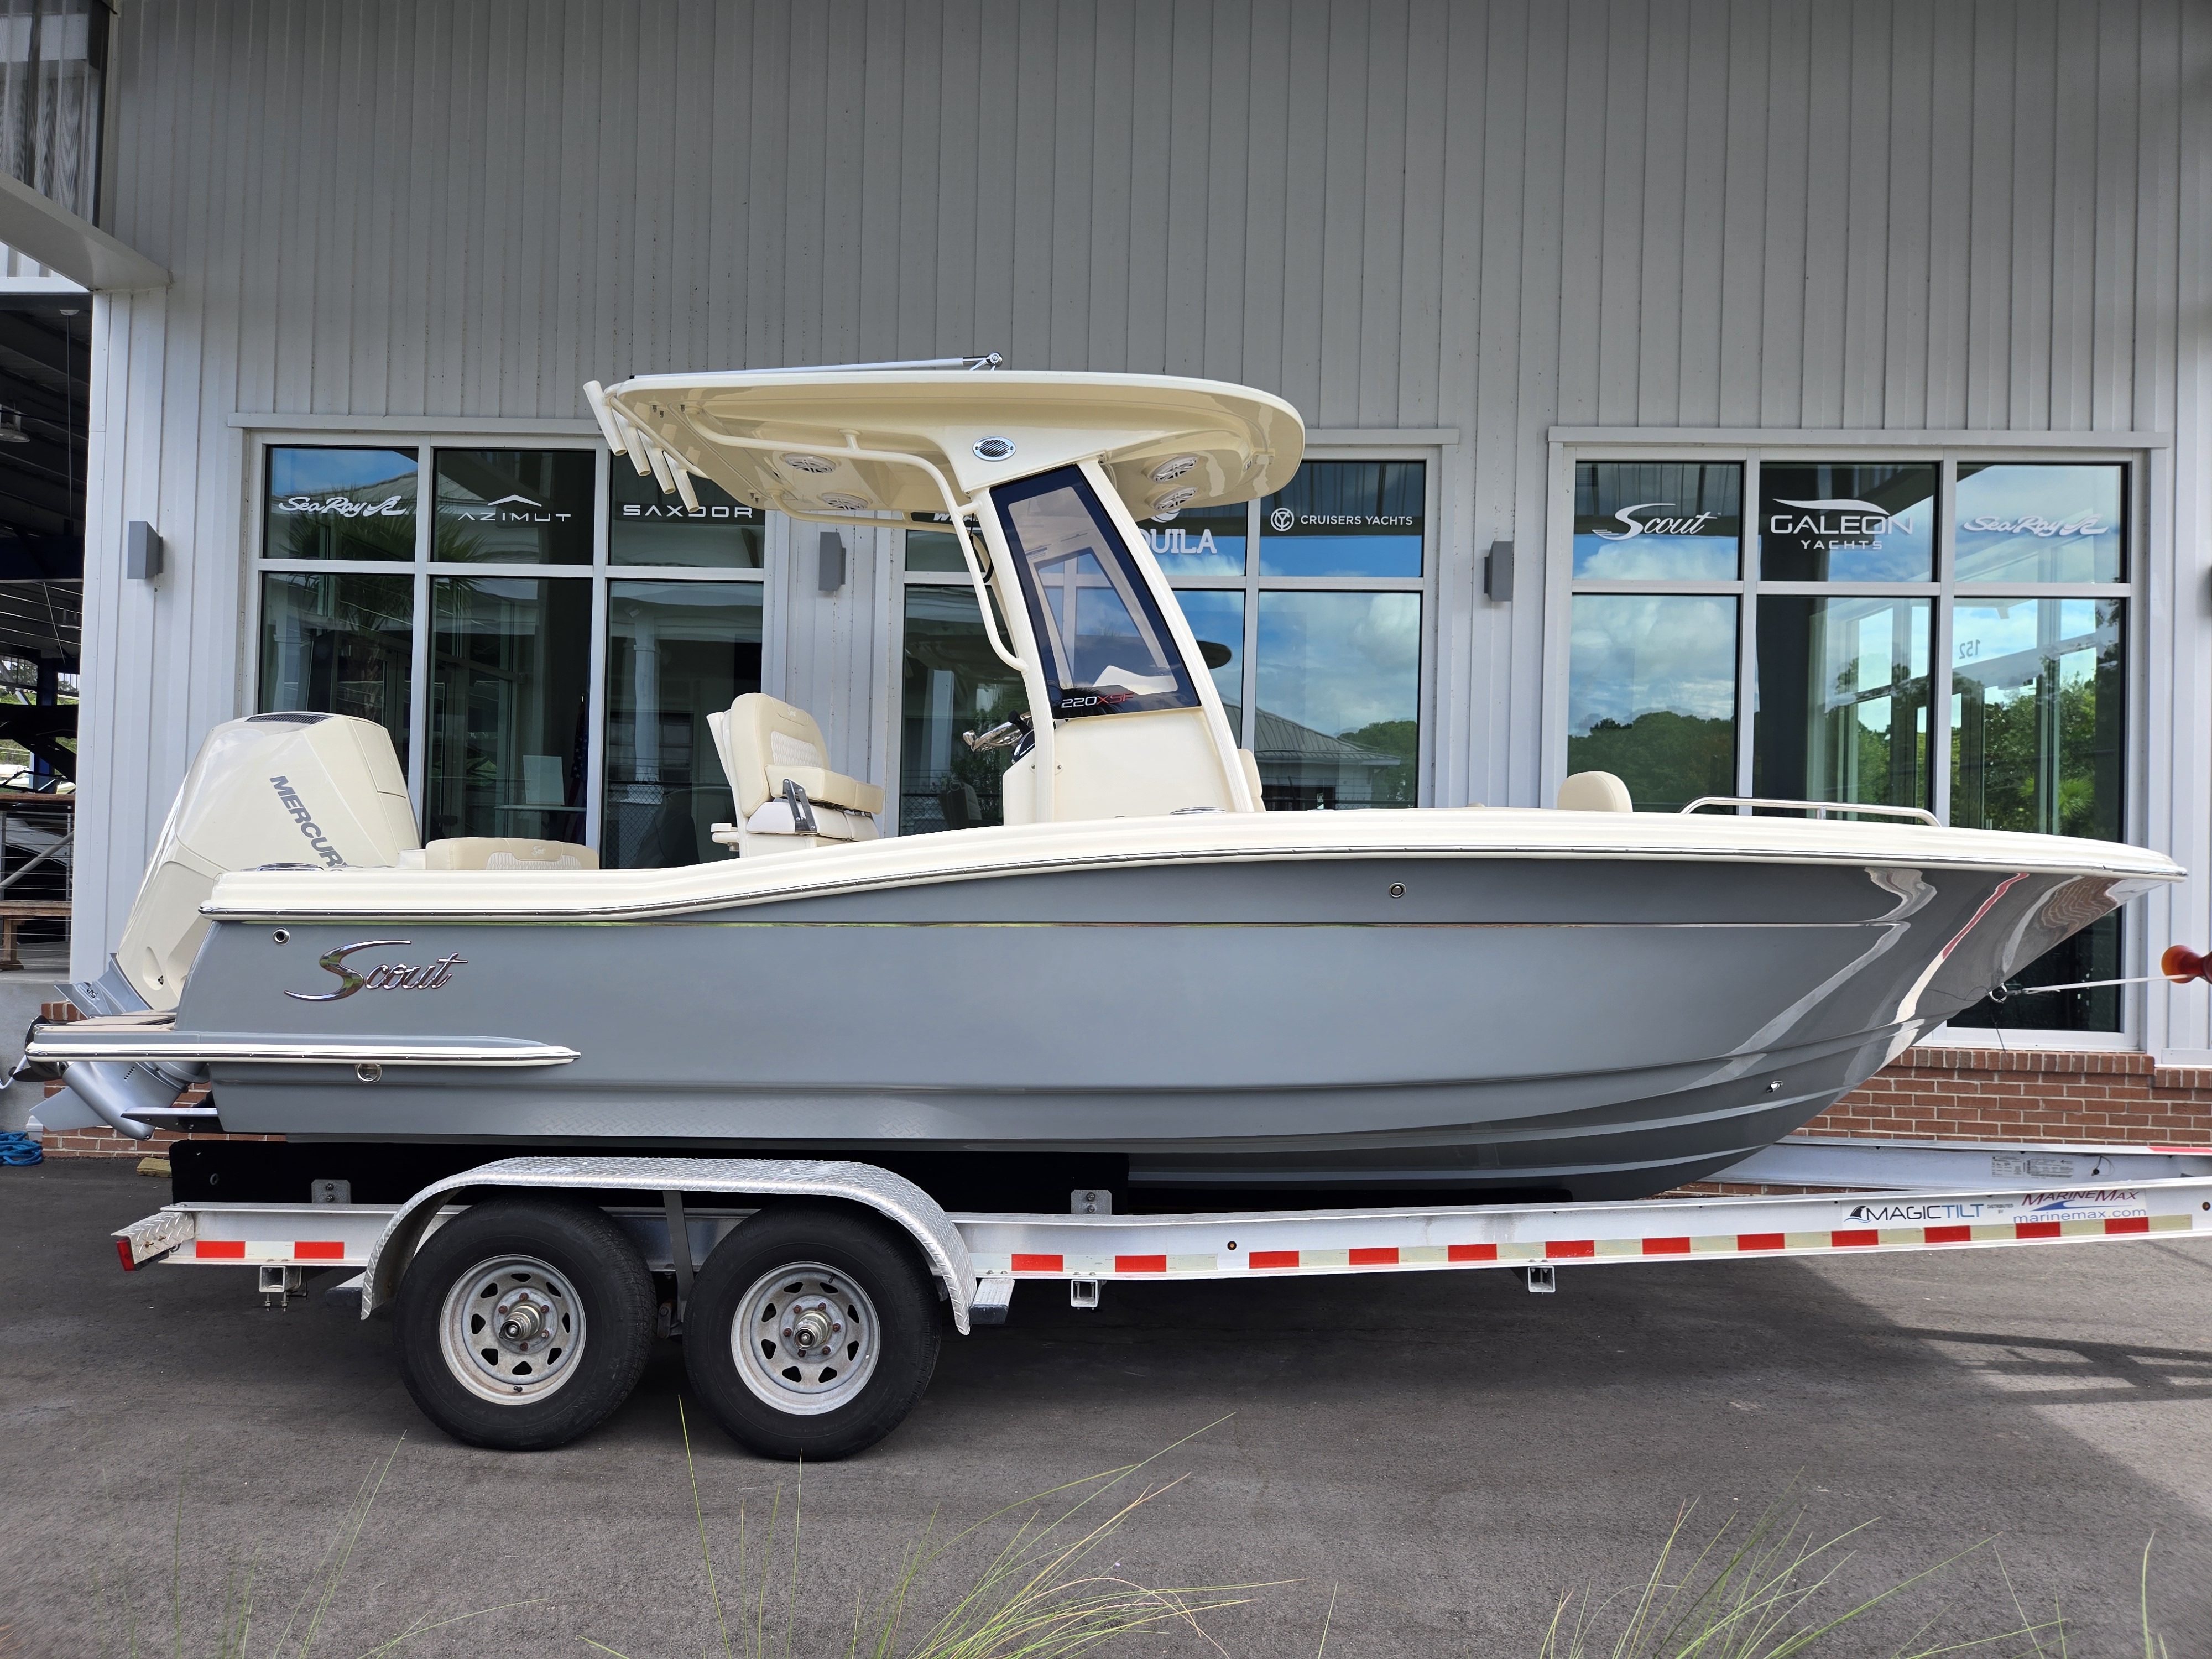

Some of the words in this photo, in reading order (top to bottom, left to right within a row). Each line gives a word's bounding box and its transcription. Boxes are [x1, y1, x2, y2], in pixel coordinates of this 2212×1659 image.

[278, 497, 325, 512] Sea
[321, 497, 367, 518] Ray
[458, 512, 571, 522] AZIMUT
[623, 505, 753, 518] SAXDOR
[1300, 515, 1361, 525] CRUISERS
[1365, 515, 1413, 525] YACHTS
[1592, 503, 1718, 541] Scout
[1771, 515, 1913, 535] GALEON
[1964, 515, 2016, 531] Sea
[2012, 515, 2063, 537] Ray
[1139, 528, 1217, 554] UILA
[1801, 540, 1883, 550] YACHTS
[269, 775, 348, 867] MERCUR
[284, 940, 468, 1002] Scout
[2013, 1209, 2147, 1224] marinemax.com
